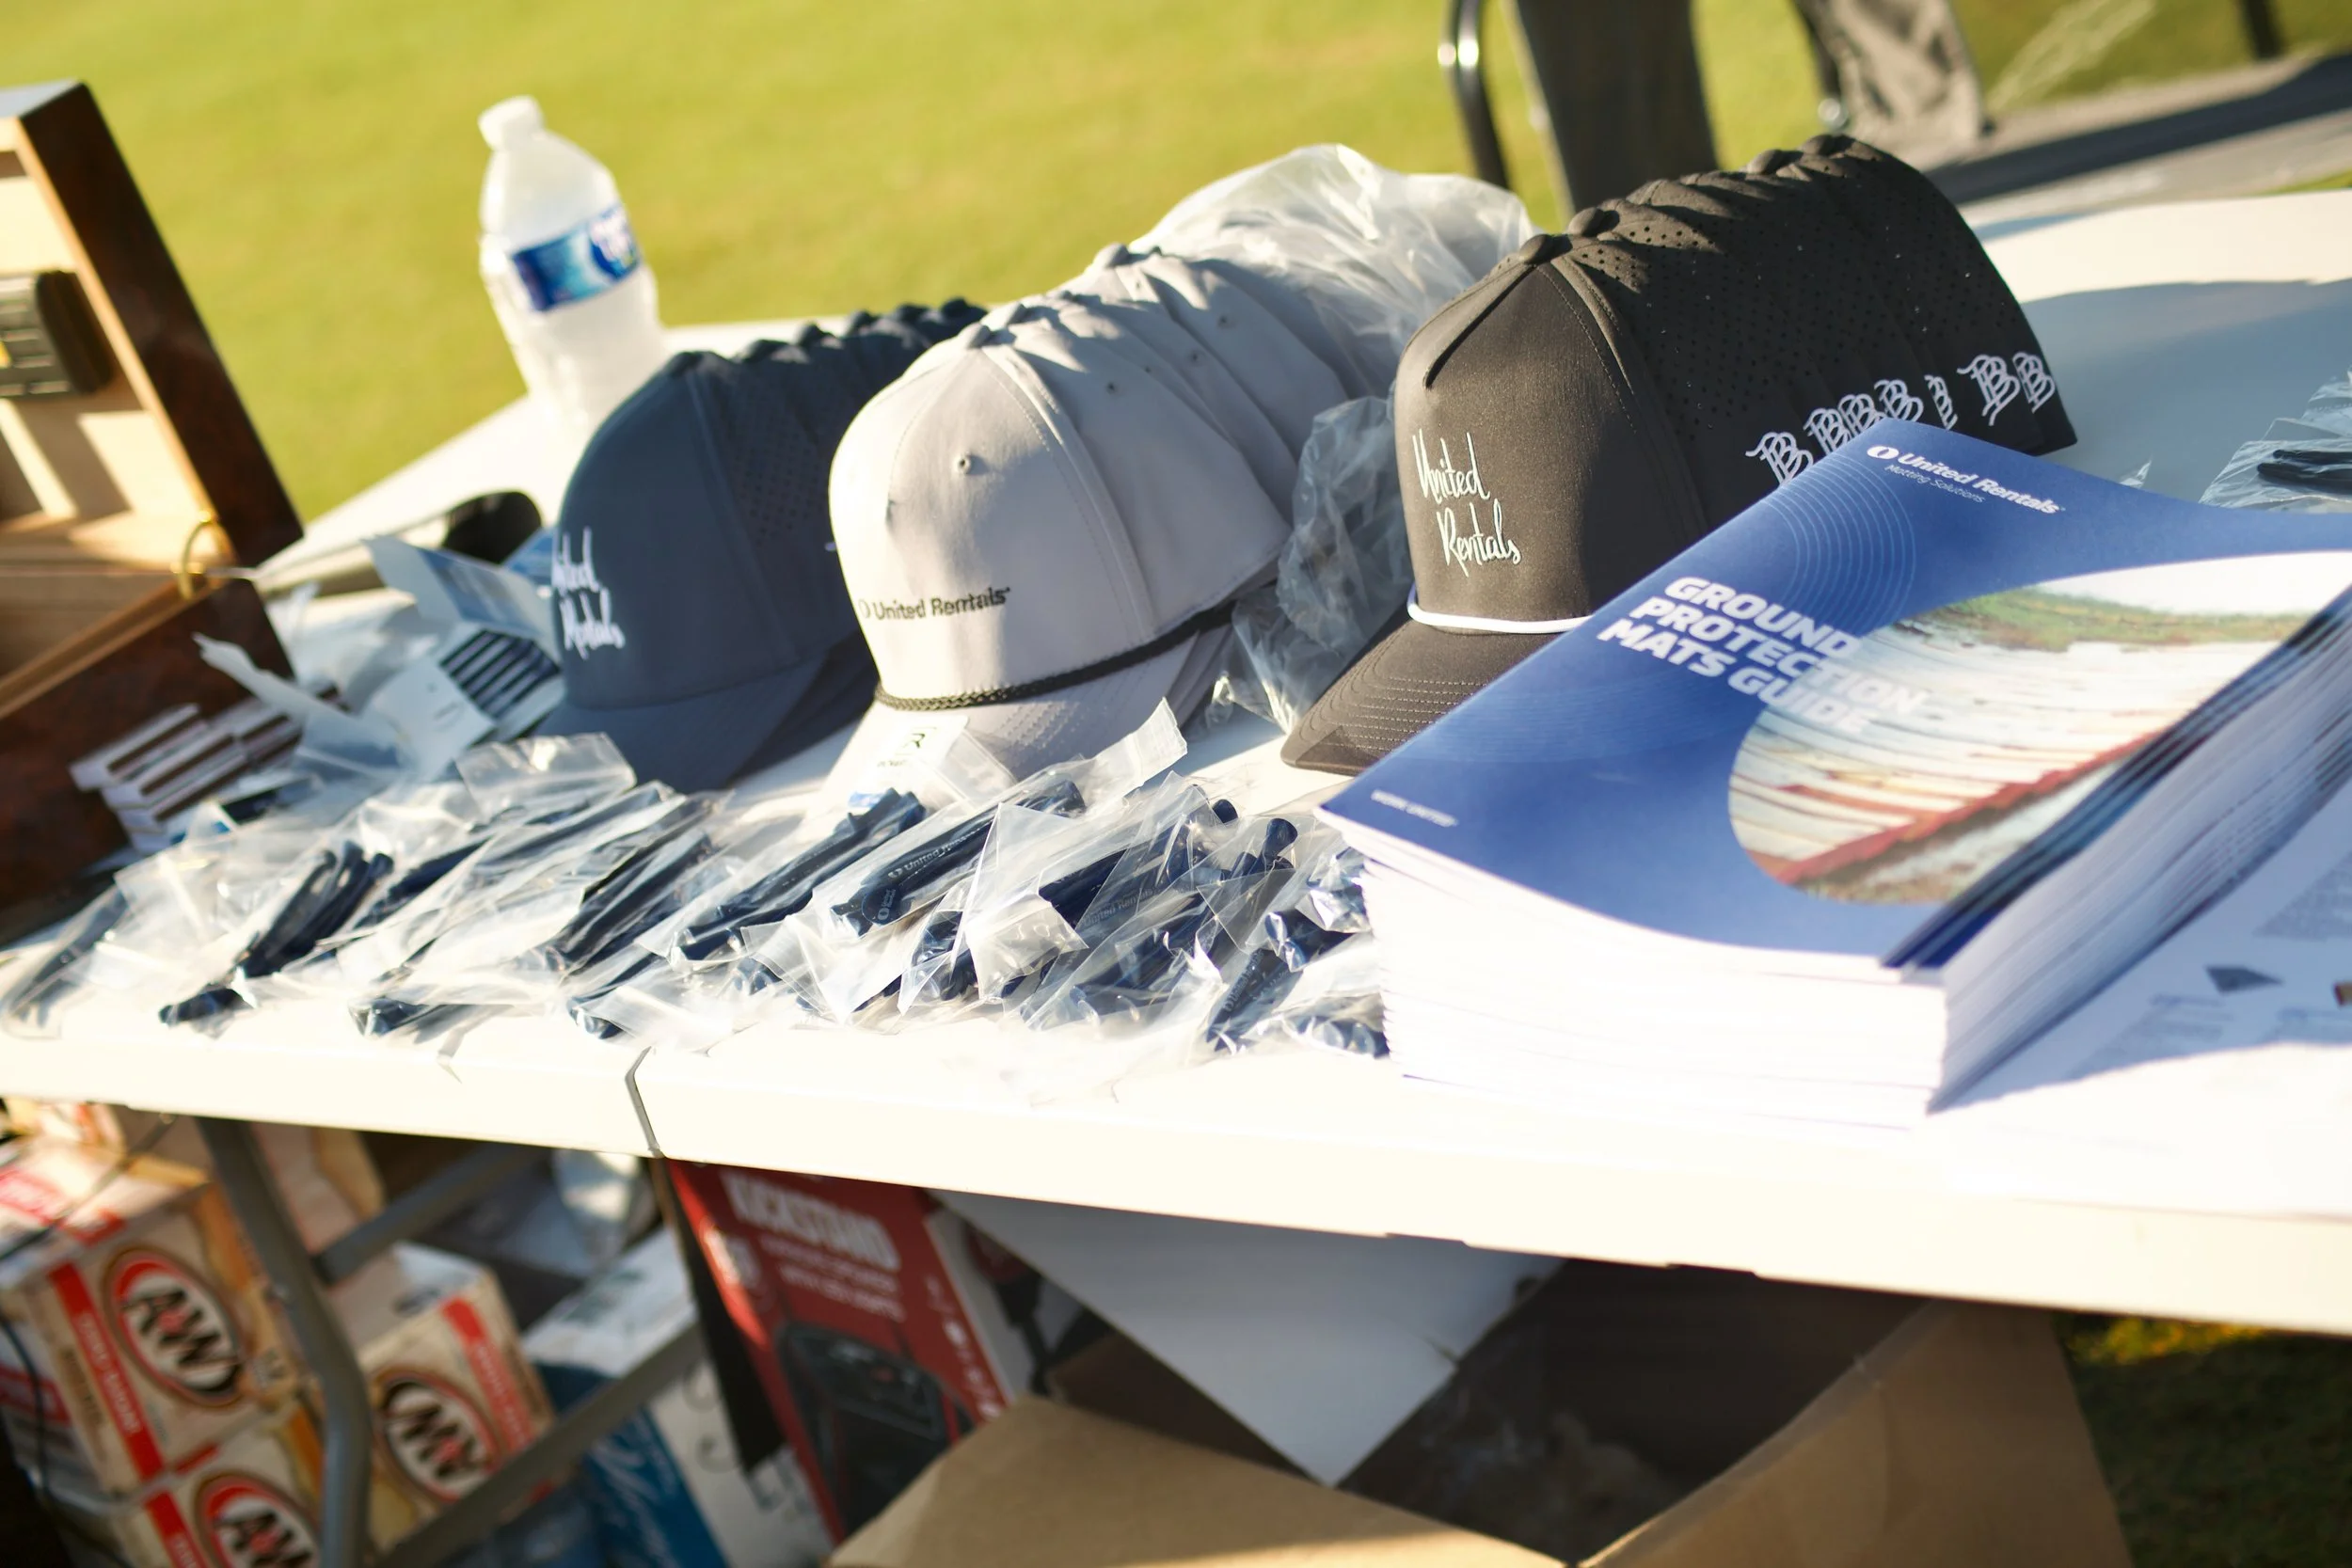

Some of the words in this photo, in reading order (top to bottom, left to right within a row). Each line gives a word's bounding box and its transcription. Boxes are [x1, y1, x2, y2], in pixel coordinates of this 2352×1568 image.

[1413, 428, 1490, 504] United
[1884, 464, 1931, 484] Matting
[1930, 478, 1986, 503] Solutions
[1897, 452, 1979, 484] United
[1972, 478, 2060, 514] Rentals
[1437, 498, 1522, 578] Rentals
[873, 598, 926, 621] United
[1664, 576, 1863, 658] GROUND
[1597, 618, 1737, 678] MATS
[1727, 666, 1875, 734] GUIDE
[1629, 595, 1927, 713] PROTECTION
[120, 1288, 226, 1370] A&W
